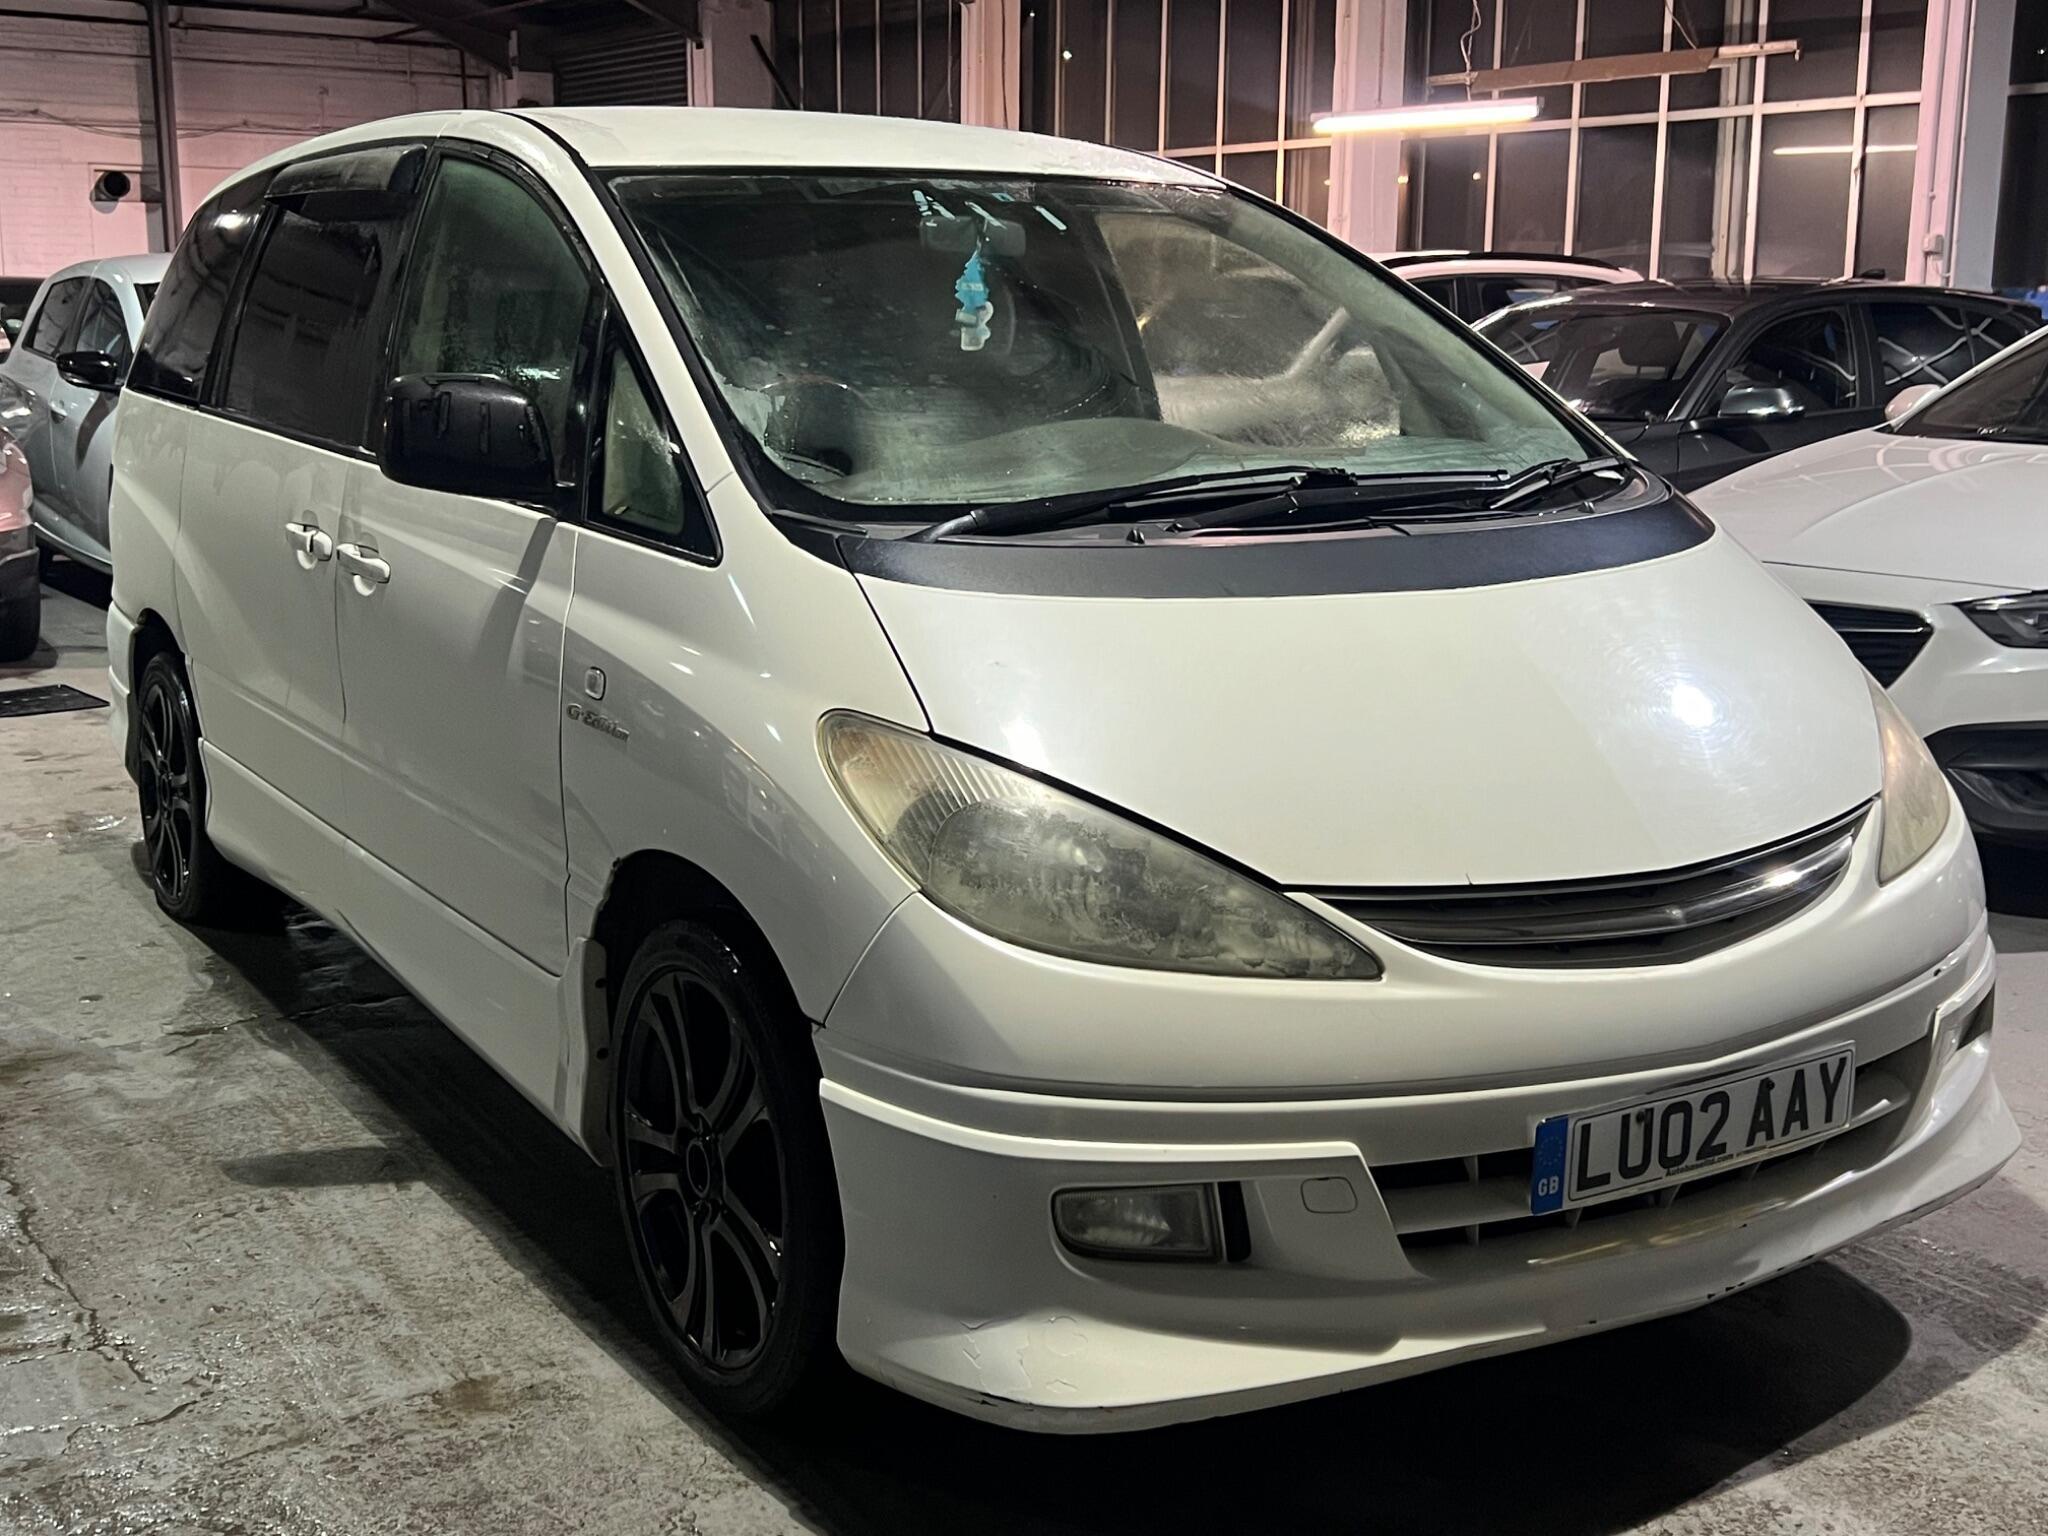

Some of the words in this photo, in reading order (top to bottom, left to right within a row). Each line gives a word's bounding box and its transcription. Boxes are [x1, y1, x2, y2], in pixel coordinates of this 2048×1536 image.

[1576, 1090, 1731, 1192] LU02
[1746, 1056, 1848, 1147] AAY
[1537, 1175, 1560, 1197] GB
